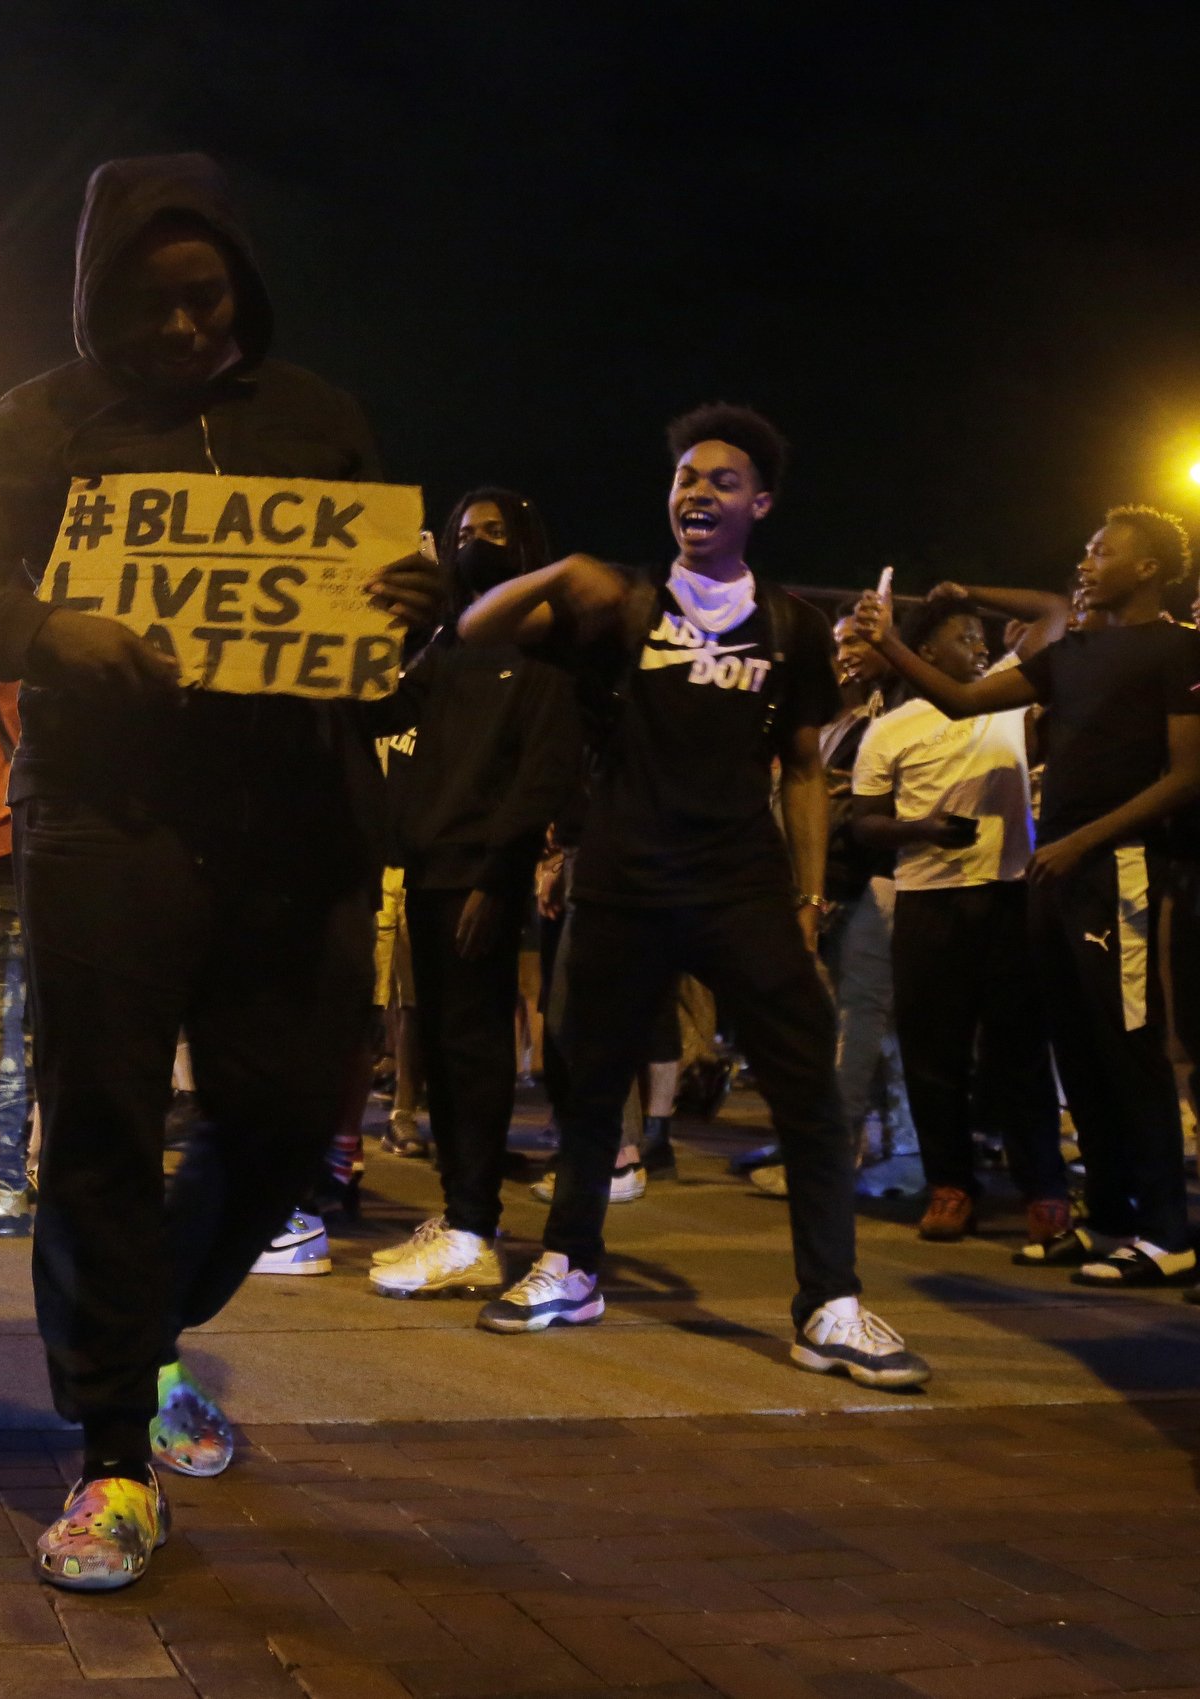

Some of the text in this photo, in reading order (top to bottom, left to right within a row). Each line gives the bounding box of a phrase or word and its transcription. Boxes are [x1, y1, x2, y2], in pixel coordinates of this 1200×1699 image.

[64, 488, 366, 551] #BLACK
[51, 560, 308, 626] LIVES
[142, 623, 402, 697] ATTER
